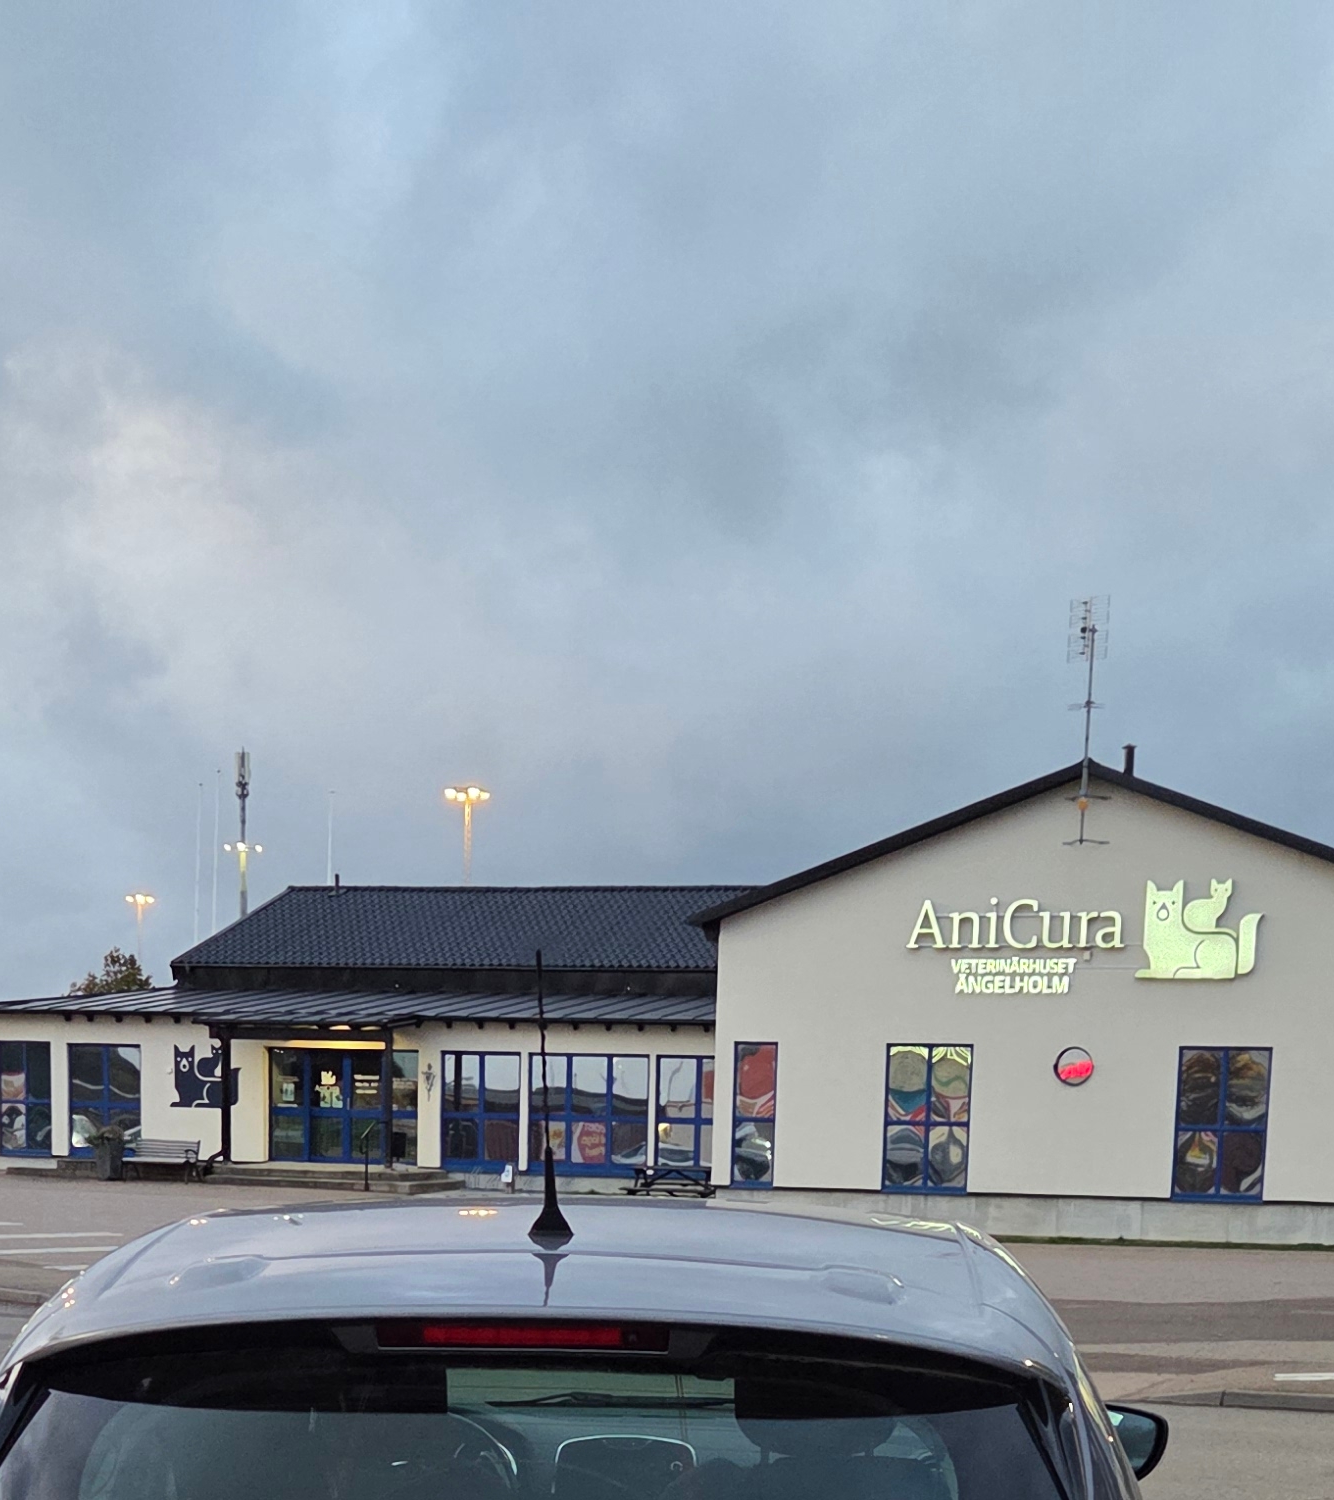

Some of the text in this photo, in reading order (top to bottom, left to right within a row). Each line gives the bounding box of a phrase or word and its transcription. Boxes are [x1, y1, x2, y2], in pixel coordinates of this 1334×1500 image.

[906, 897, 1125, 948] AniCura
[950, 956, 1077, 974] VETERINÄRHUSET
[954, 974, 1070, 994] ÄNGELHOLM
